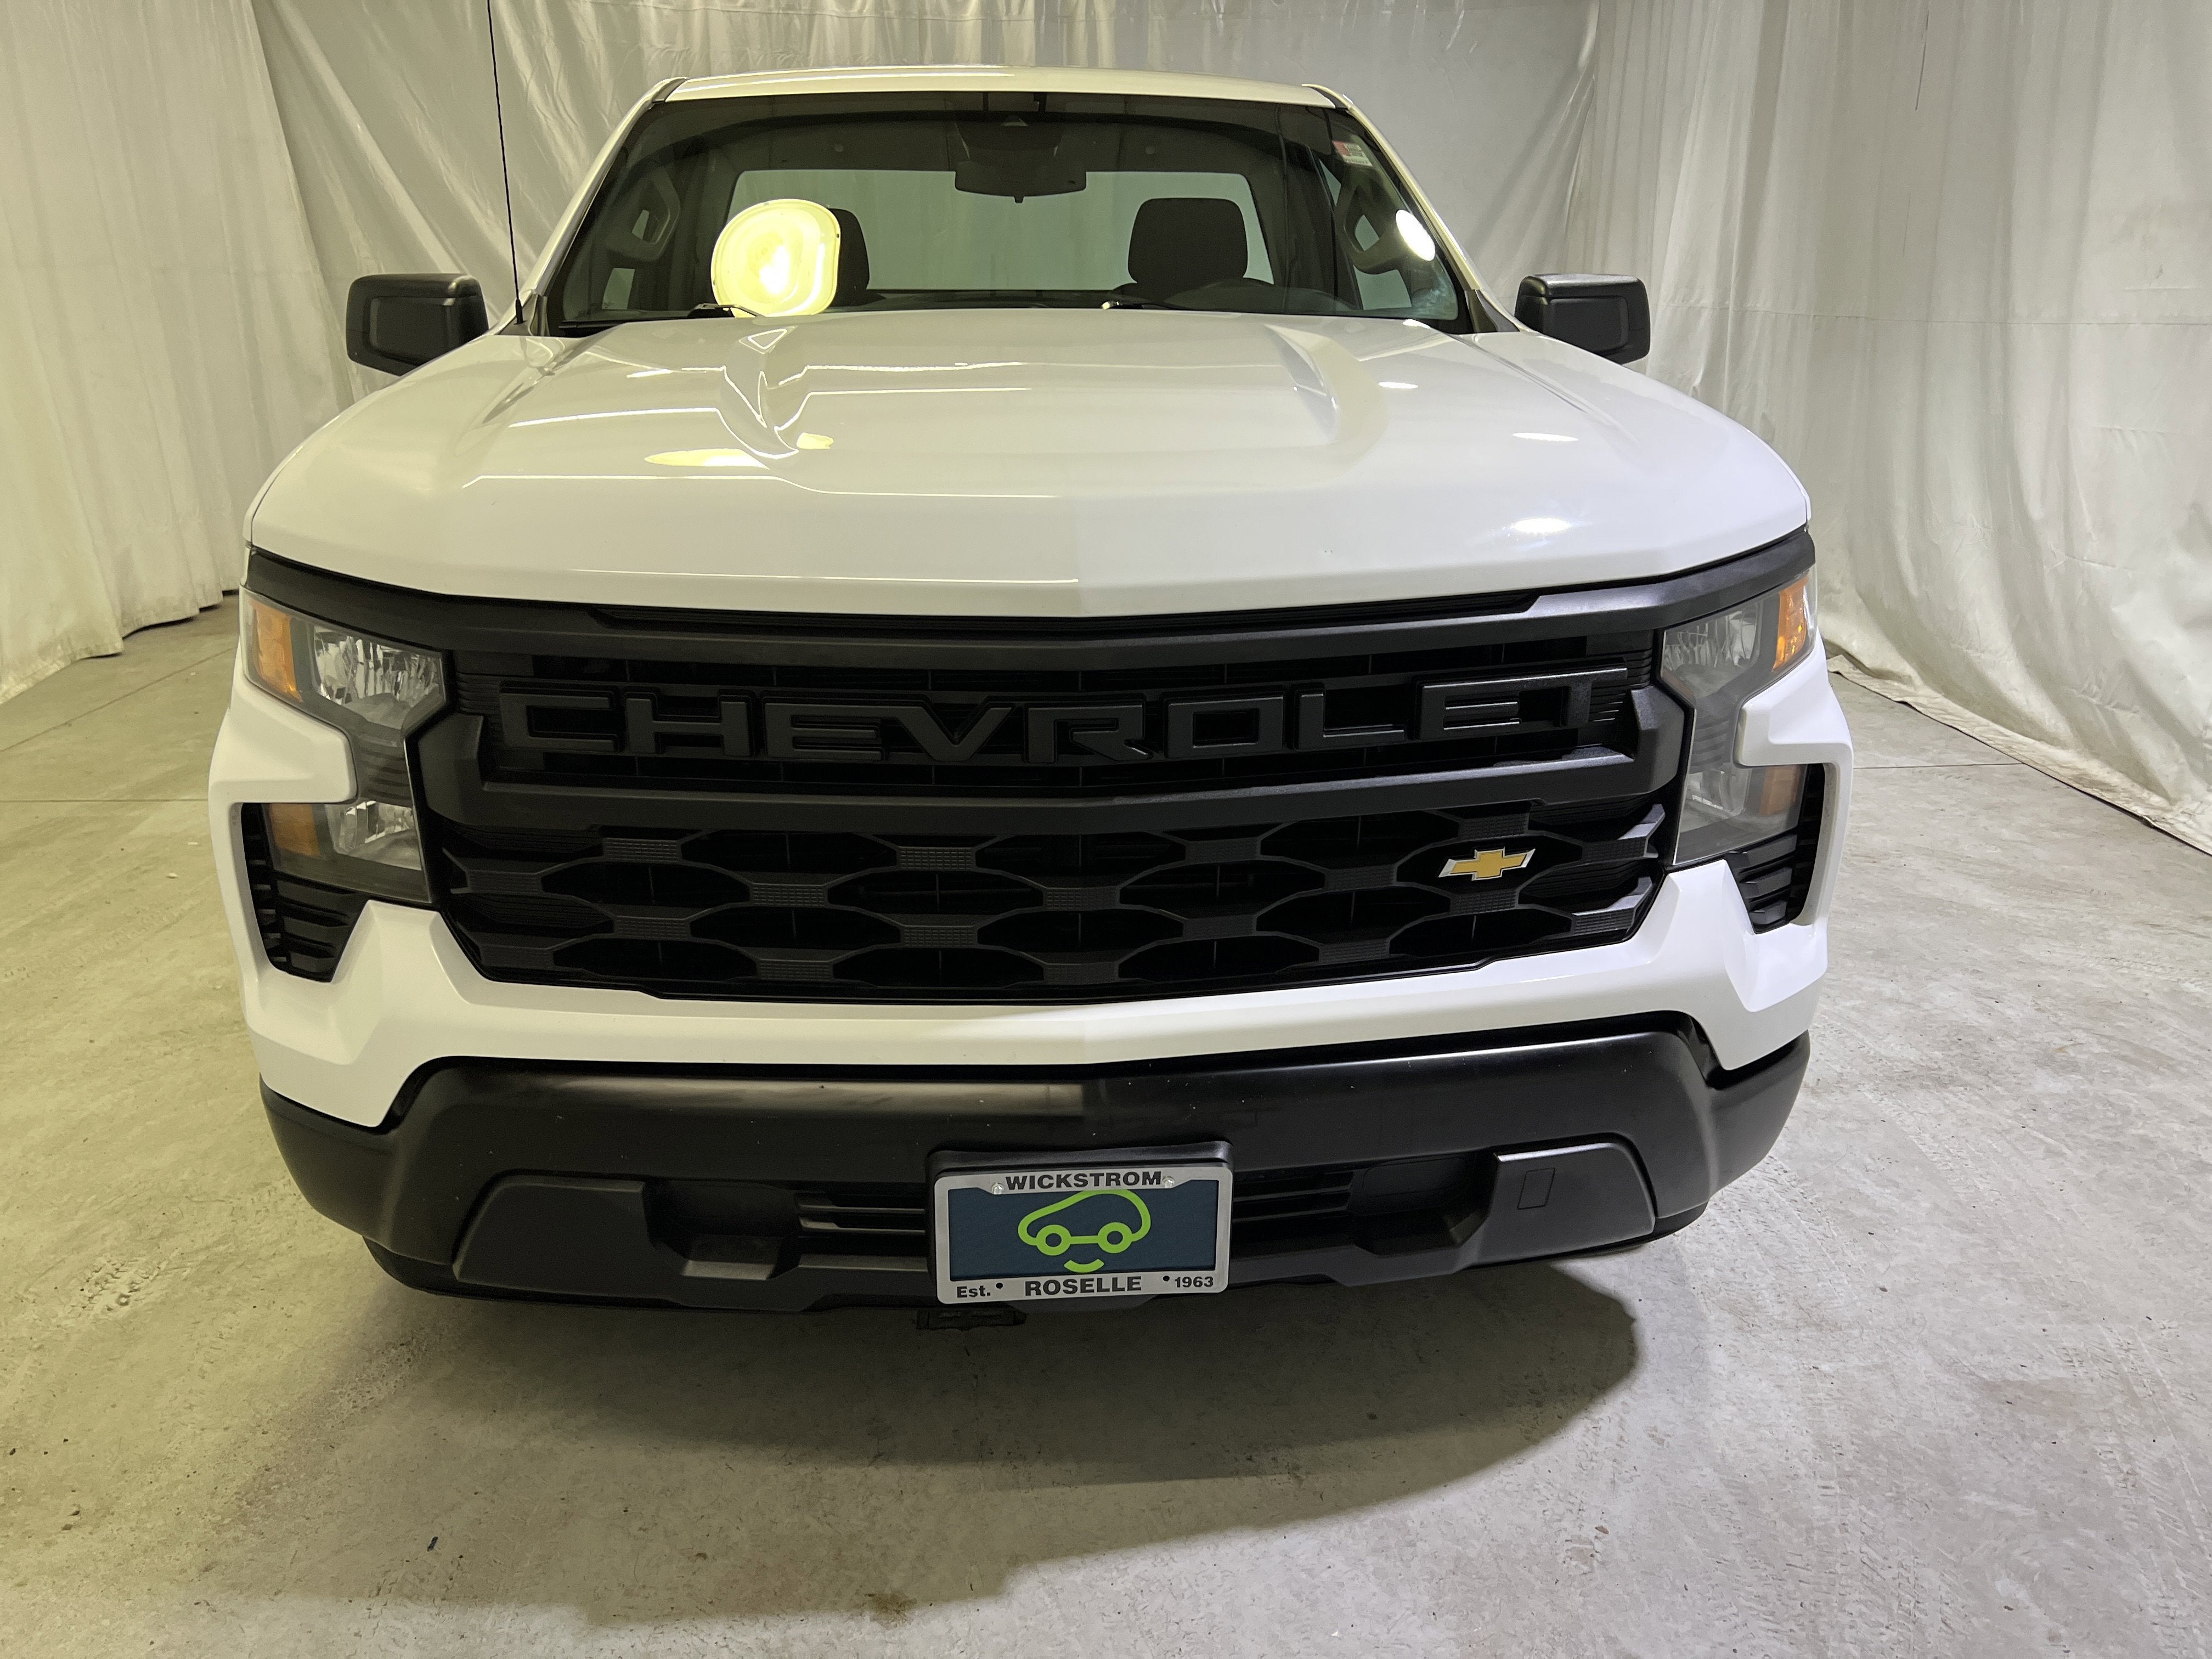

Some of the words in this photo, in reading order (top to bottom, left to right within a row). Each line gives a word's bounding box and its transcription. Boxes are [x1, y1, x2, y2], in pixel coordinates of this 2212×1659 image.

[499, 667, 1629, 763] CHEVROLET
[1006, 1171, 1161, 1190] WICKSTROM
[957, 1286, 991, 1298] Est.
[1025, 1276, 1142, 1296] ROSELLE
[1174, 1276, 1214, 1288] 1963
